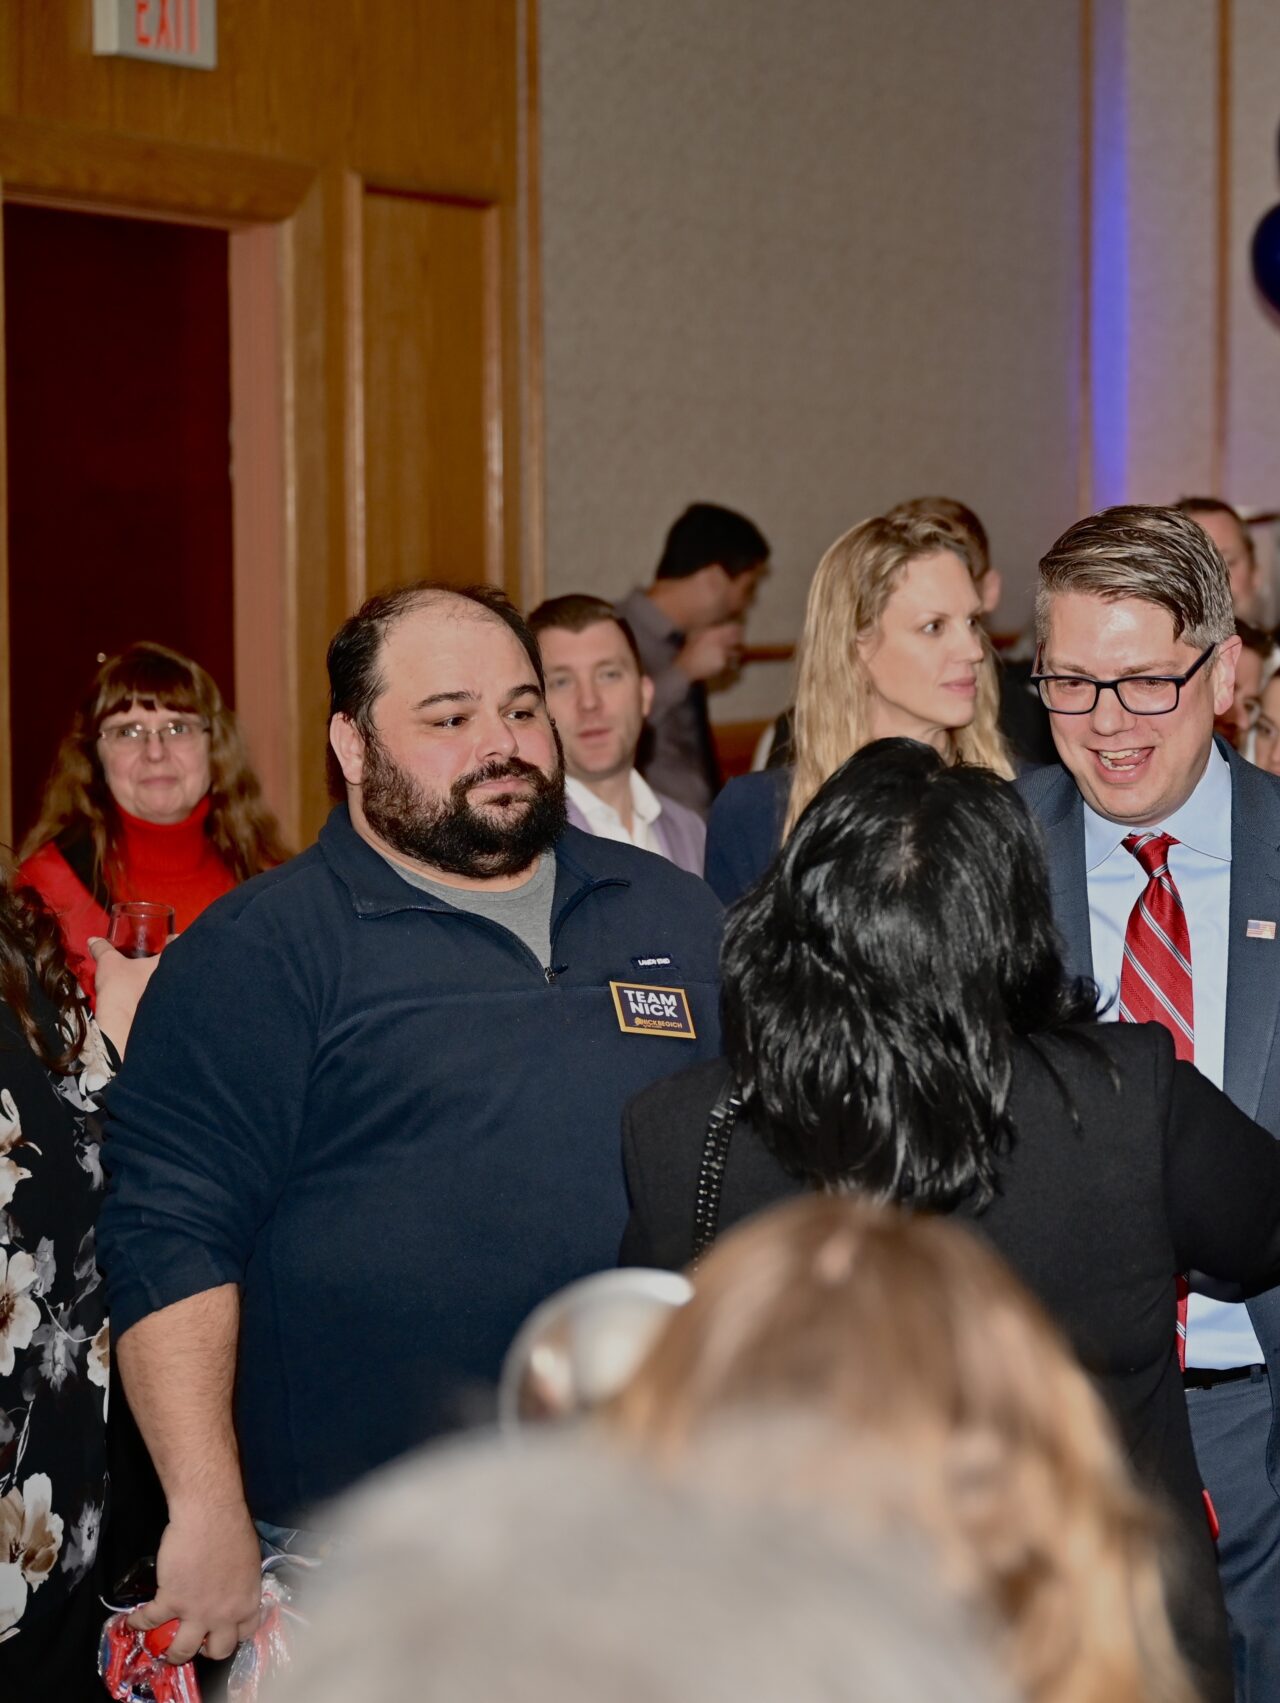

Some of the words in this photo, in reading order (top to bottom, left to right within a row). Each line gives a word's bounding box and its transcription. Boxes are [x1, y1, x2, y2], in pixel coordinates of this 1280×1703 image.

[134, 0, 198, 53] EXIT
[623, 989, 677, 1007] TEAM
[629, 1001, 678, 1018] NICK
